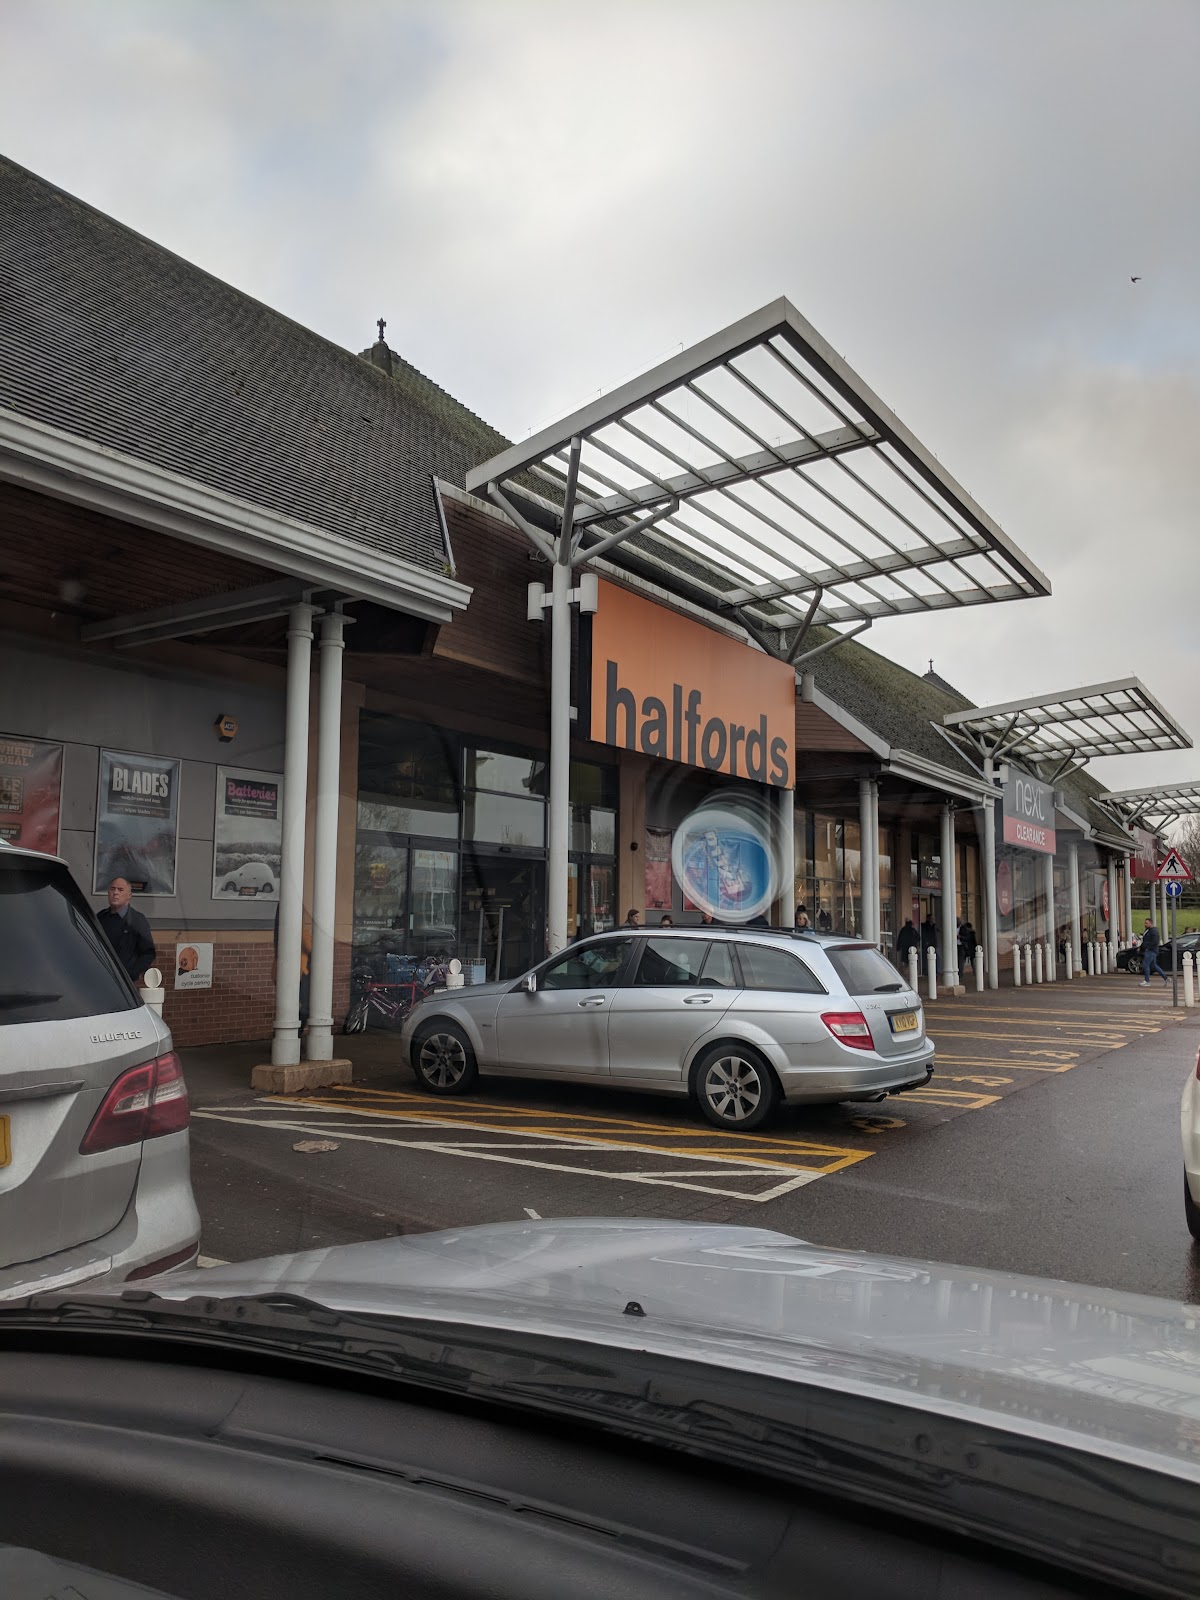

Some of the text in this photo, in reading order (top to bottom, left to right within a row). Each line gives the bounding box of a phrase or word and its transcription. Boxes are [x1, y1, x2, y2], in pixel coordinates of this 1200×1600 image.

[606, 659, 789, 788] halfords
[112, 767, 169, 798] BLADES
[227, 781, 276, 800] Batteries
[1015, 779, 1045, 821] next
[1016, 824, 1046, 846] CLEARANCE
[89, 1030, 142, 1044] BLUETEC
